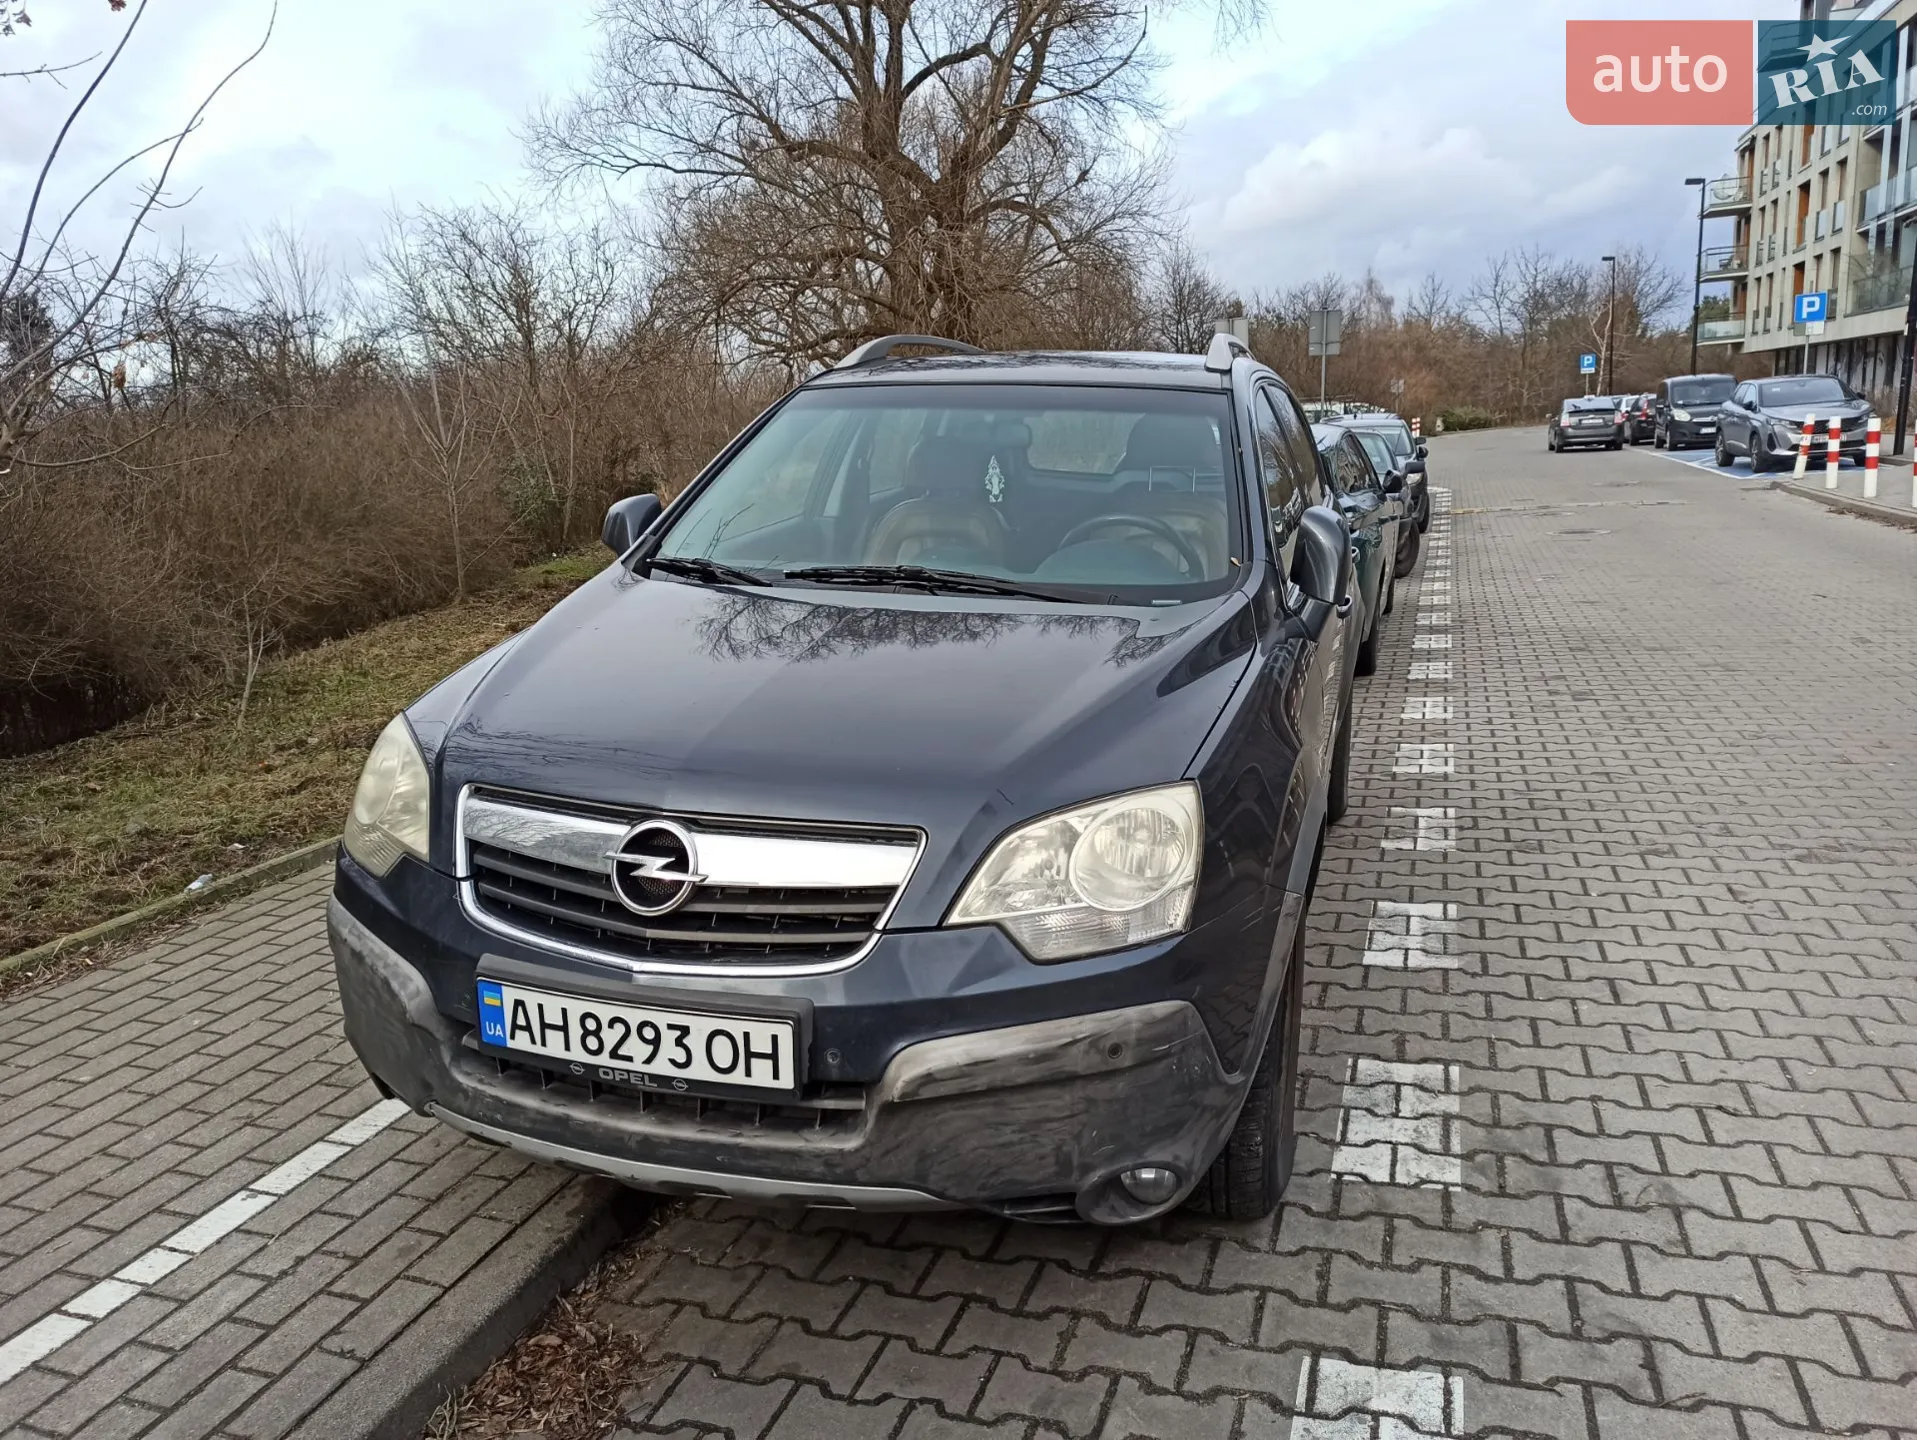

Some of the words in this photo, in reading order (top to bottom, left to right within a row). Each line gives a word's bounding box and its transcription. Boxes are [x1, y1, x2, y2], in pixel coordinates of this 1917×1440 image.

[1802, 296, 1820, 319] P
[1584, 355, 1593, 367] P
[485, 1020, 504, 1038] UA
[598, 1067, 658, 1087] OPEL
